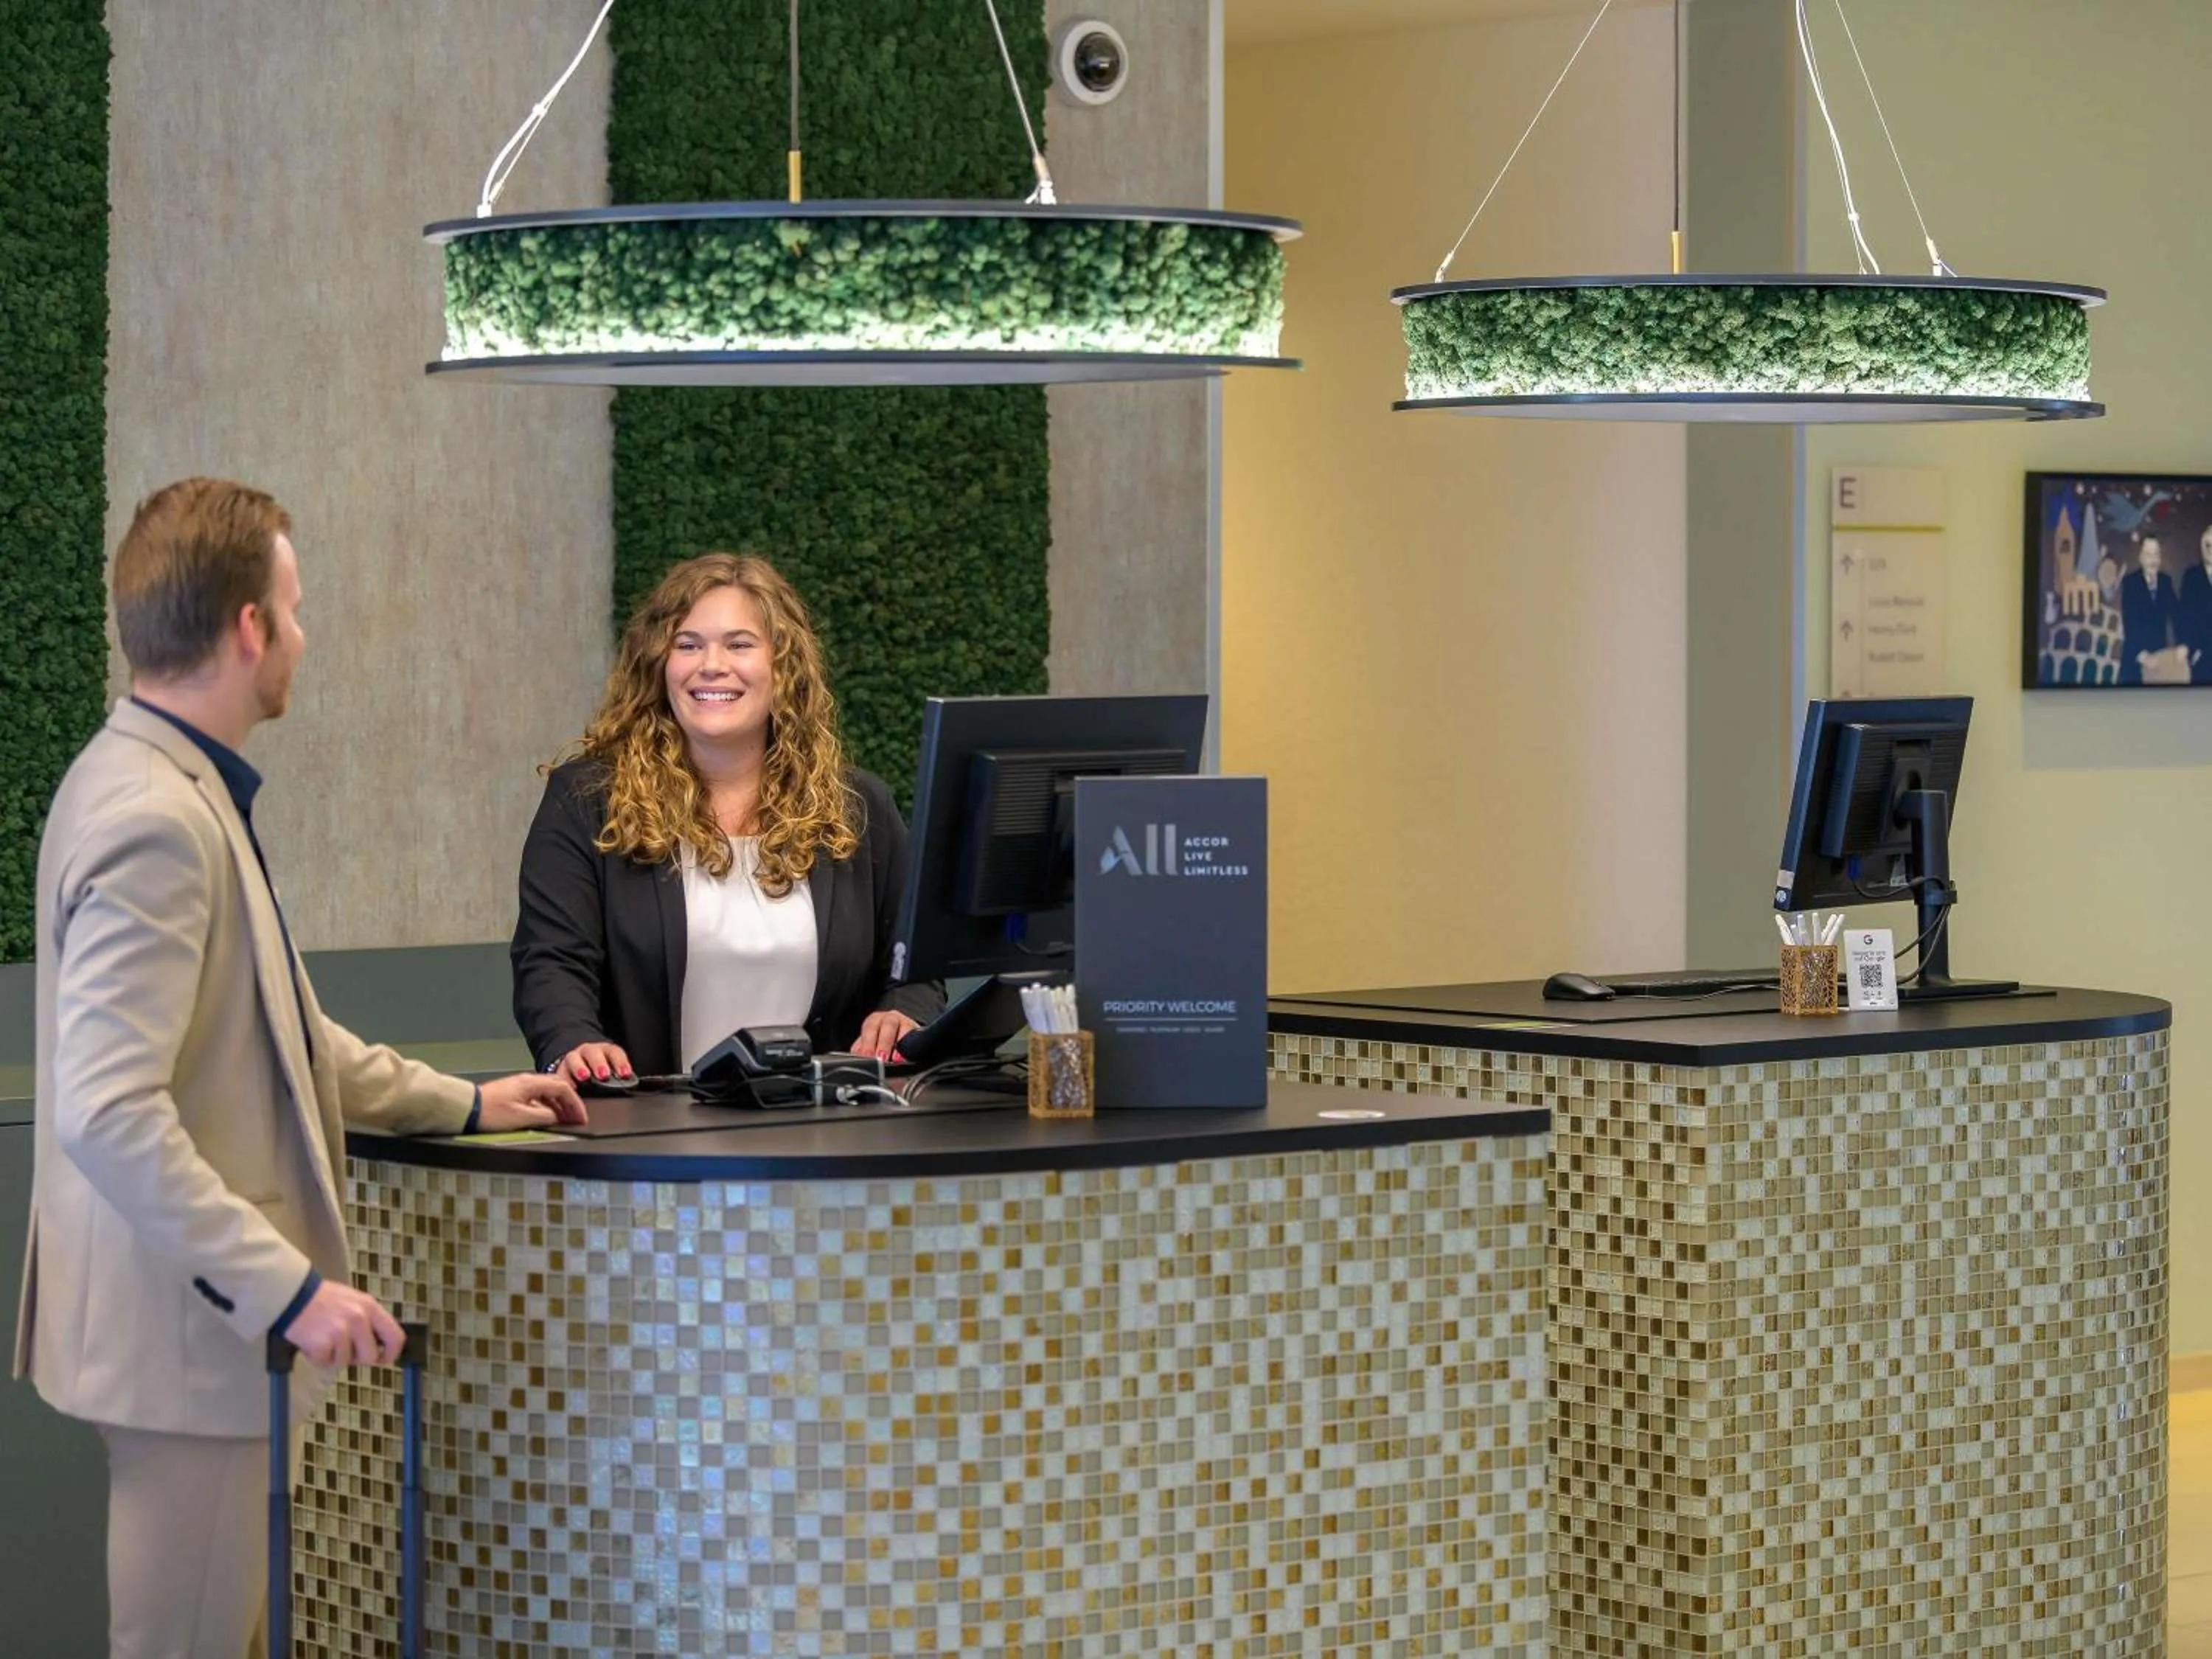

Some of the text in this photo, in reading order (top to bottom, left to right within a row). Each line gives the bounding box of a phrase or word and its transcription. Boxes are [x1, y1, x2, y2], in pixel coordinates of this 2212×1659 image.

[1839, 476, 1857, 509] E
[1183, 837, 1229, 847] ACCOR
[1183, 851, 1212, 862] LIVE
[1183, 866, 1249, 876] LIMITLESS
[1863, 934, 1874, 945] G
[1102, 1000, 1237, 1013] PRIORITY WELCOME
